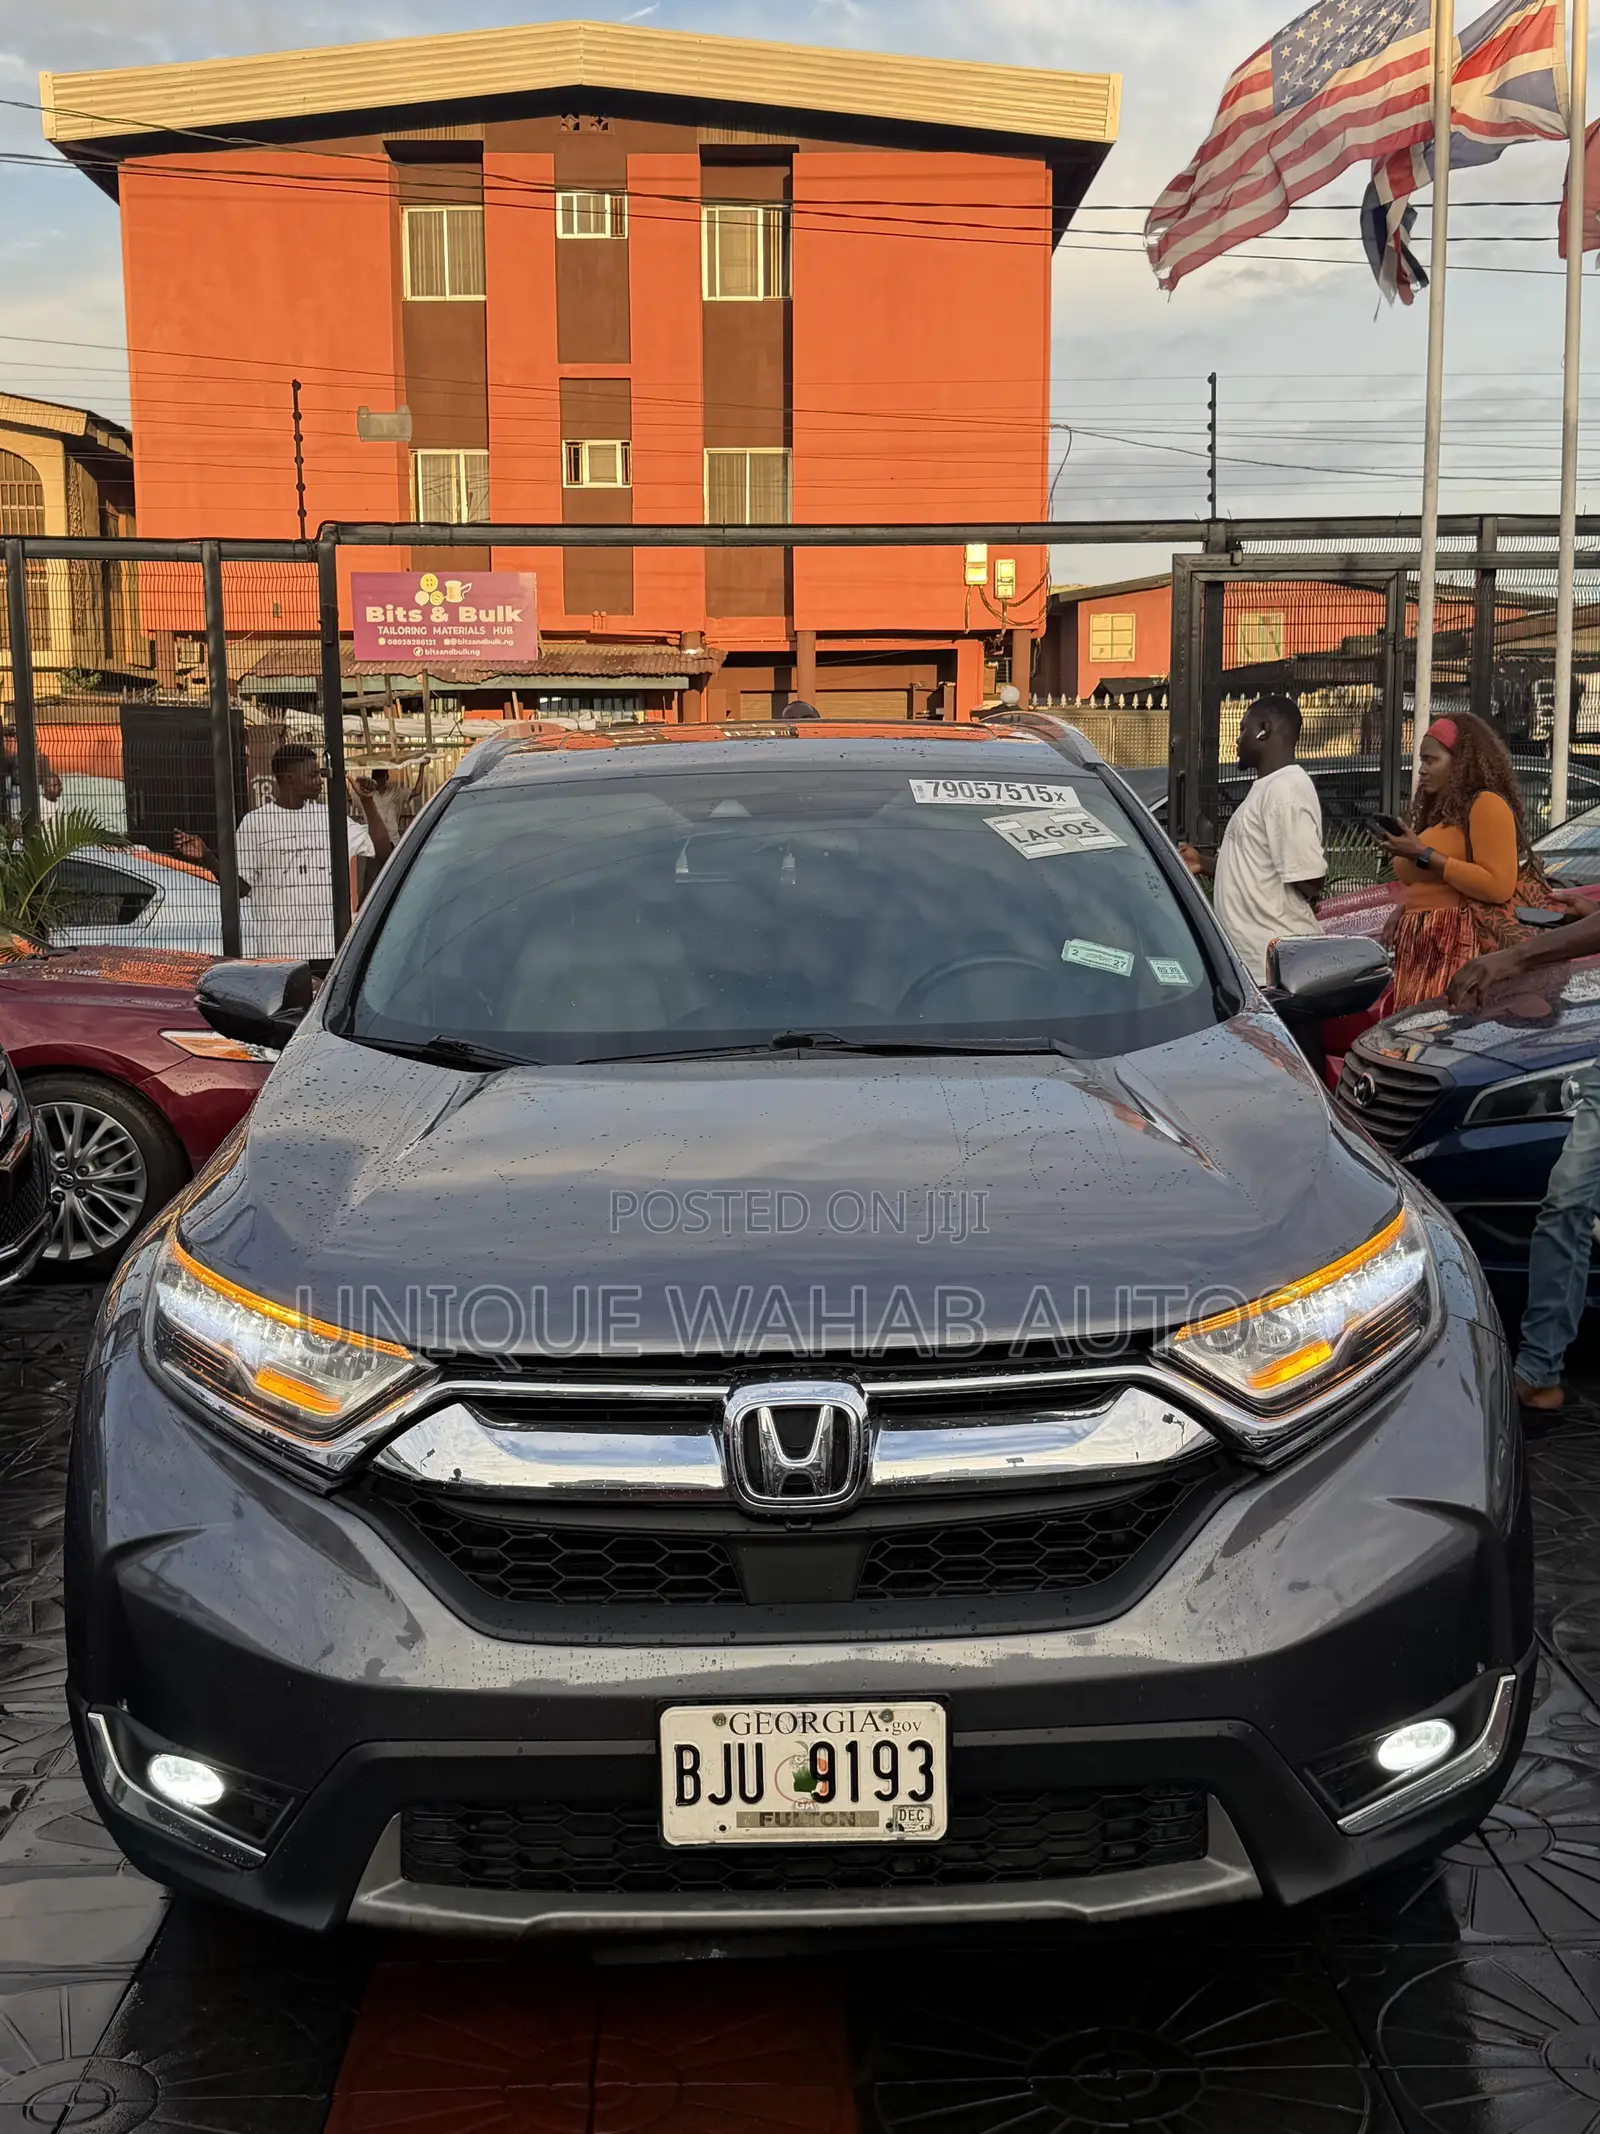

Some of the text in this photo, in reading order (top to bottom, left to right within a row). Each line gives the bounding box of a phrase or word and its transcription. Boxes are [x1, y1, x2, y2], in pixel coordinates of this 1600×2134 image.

[366, 604, 523, 623] Bits & Bulk
[378, 626, 513, 635] TAILORING MATERIALS HUB
[1008, 821, 1101, 844] LAGOS
[1072, 949, 1079, 957] 2
[1113, 960, 1127, 968] 27
[674, 1739, 934, 1806] BJU 9193
[759, 1811, 856, 1828] FULTON
[899, 1809, 924, 1821] DEC
